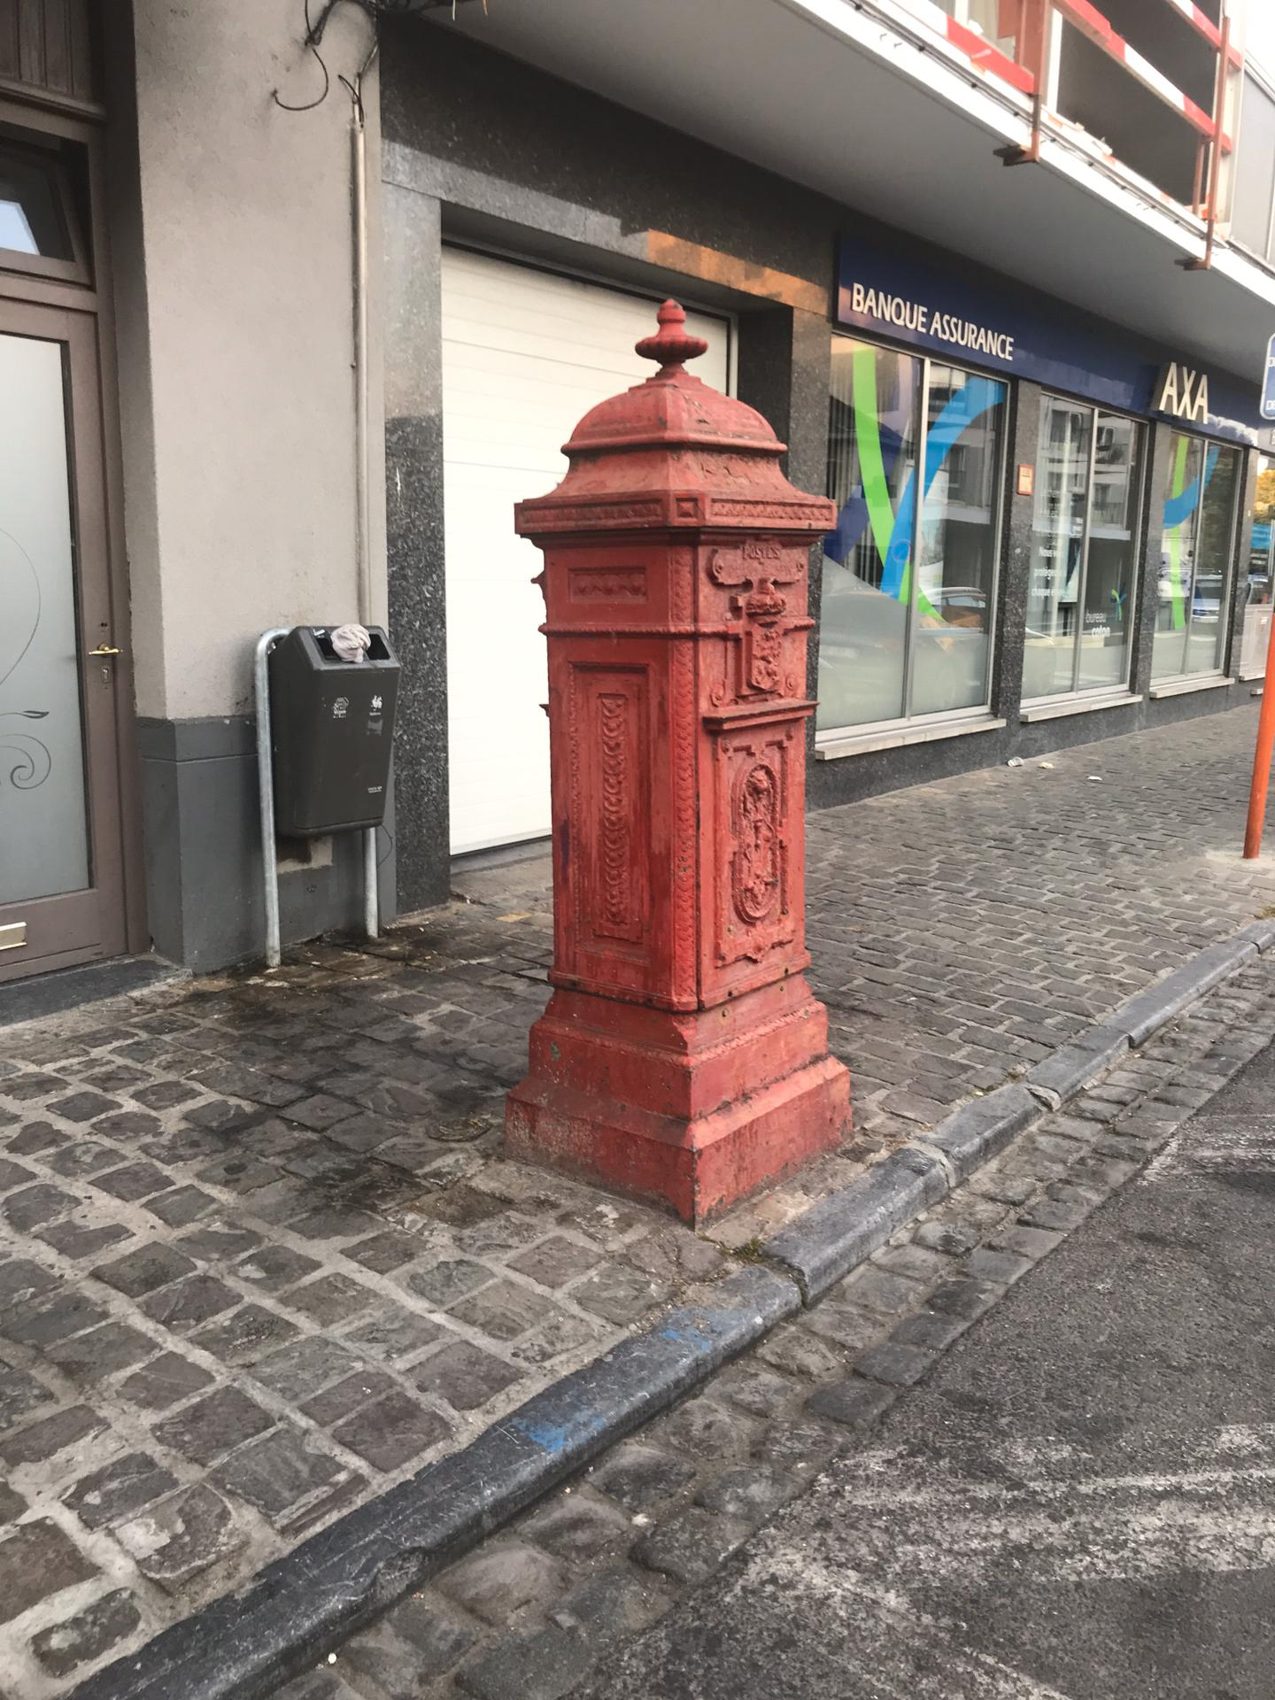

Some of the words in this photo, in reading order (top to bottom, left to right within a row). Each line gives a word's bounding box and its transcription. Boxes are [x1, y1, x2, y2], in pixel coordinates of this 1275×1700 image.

[852, 282, 928, 333] BANQUE
[930, 311, 1015, 361] ASSURANCE
[1159, 361, 1208, 425] AXA
